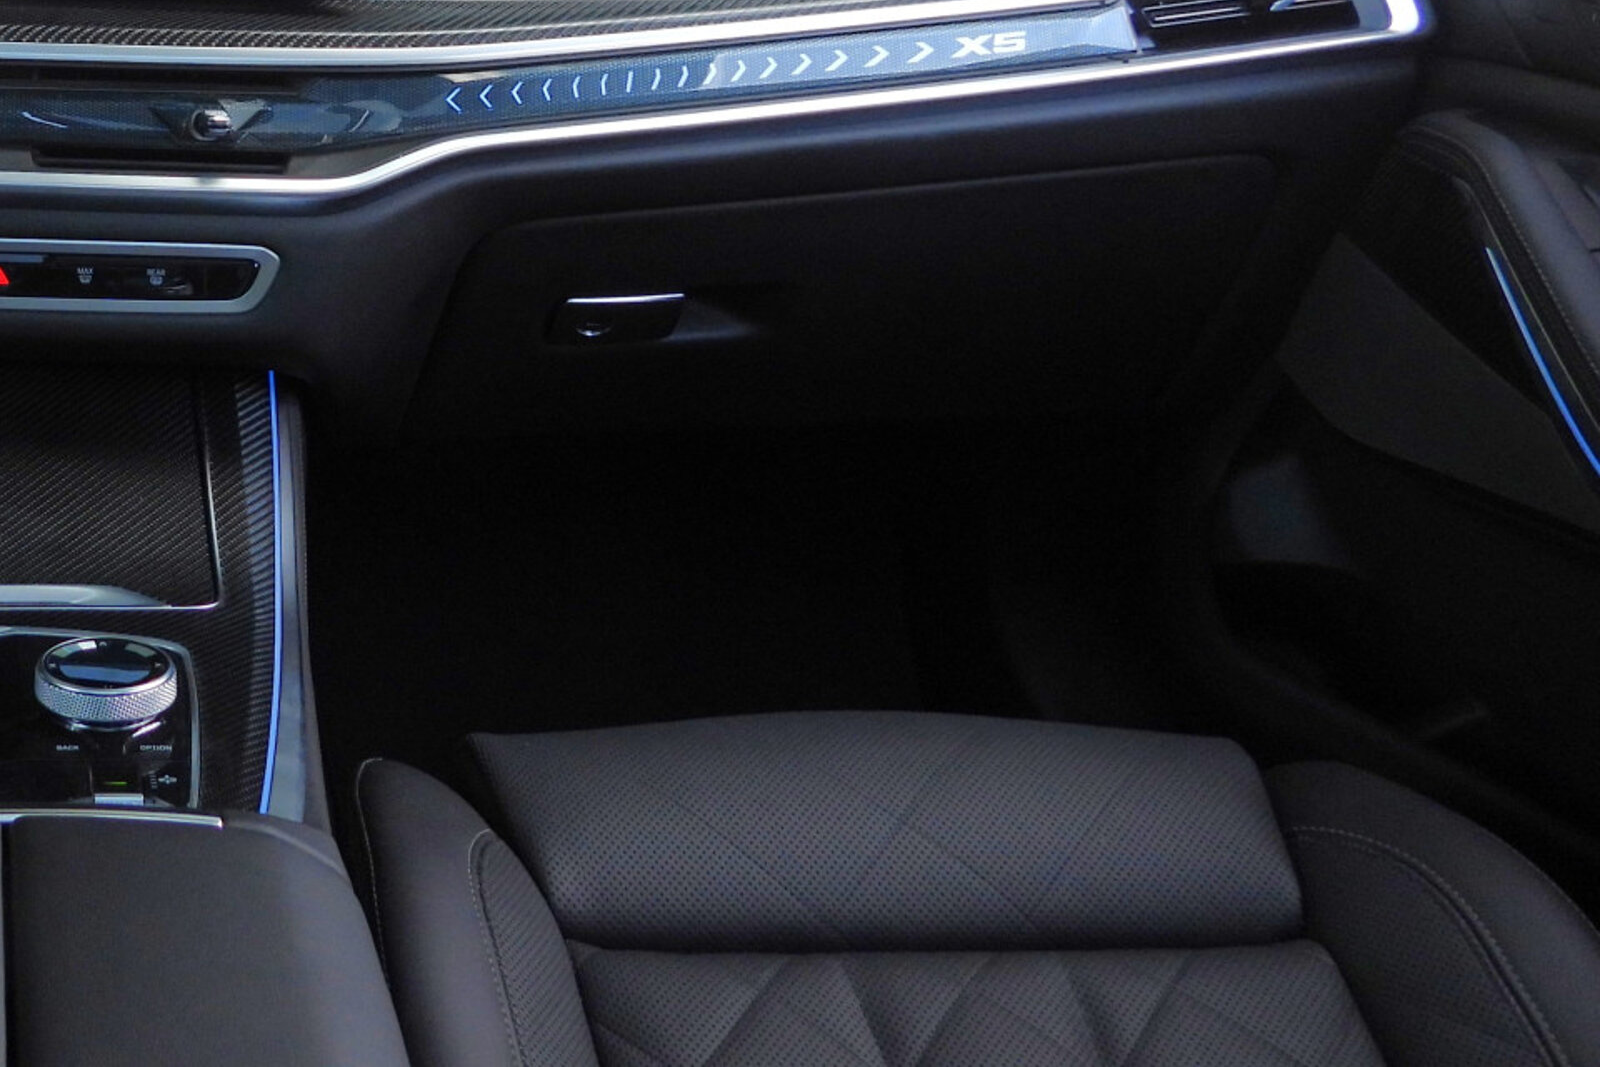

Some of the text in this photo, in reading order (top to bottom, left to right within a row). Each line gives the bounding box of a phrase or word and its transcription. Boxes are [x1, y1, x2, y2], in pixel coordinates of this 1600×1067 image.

[949, 31, 1027, 58] X5
[76, 267, 94, 275] MAX
[139, 744, 173, 752] OPTION
